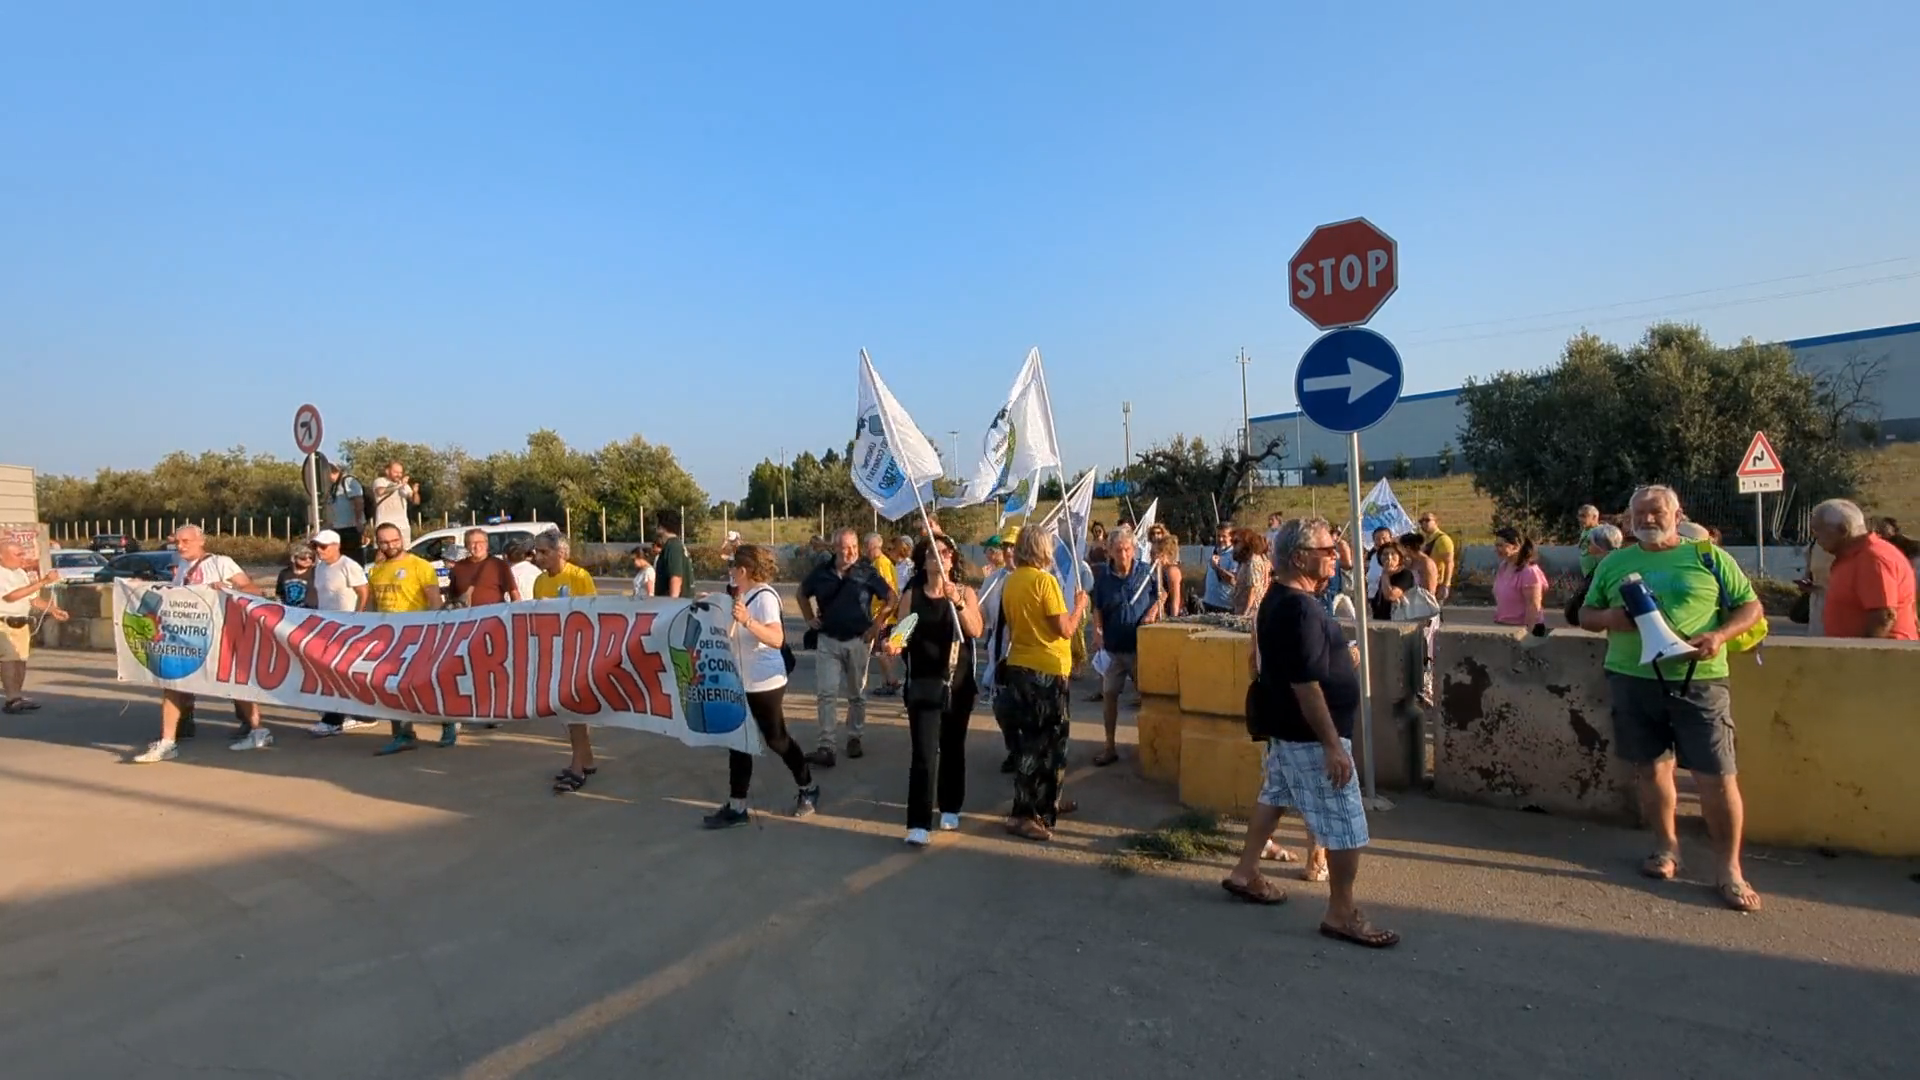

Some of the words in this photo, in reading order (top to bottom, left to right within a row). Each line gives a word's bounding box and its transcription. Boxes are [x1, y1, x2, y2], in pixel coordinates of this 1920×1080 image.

[1296, 249, 1388, 299] STOP
[1753, 480, 1756, 488] 1
[169, 600, 199, 610] UNIONE
[172, 611, 209, 620] COMITATI
[699, 639, 714, 649] DEI
[216, 597, 290, 690] NO
[288, 611, 673, 720] INCENERITORE
